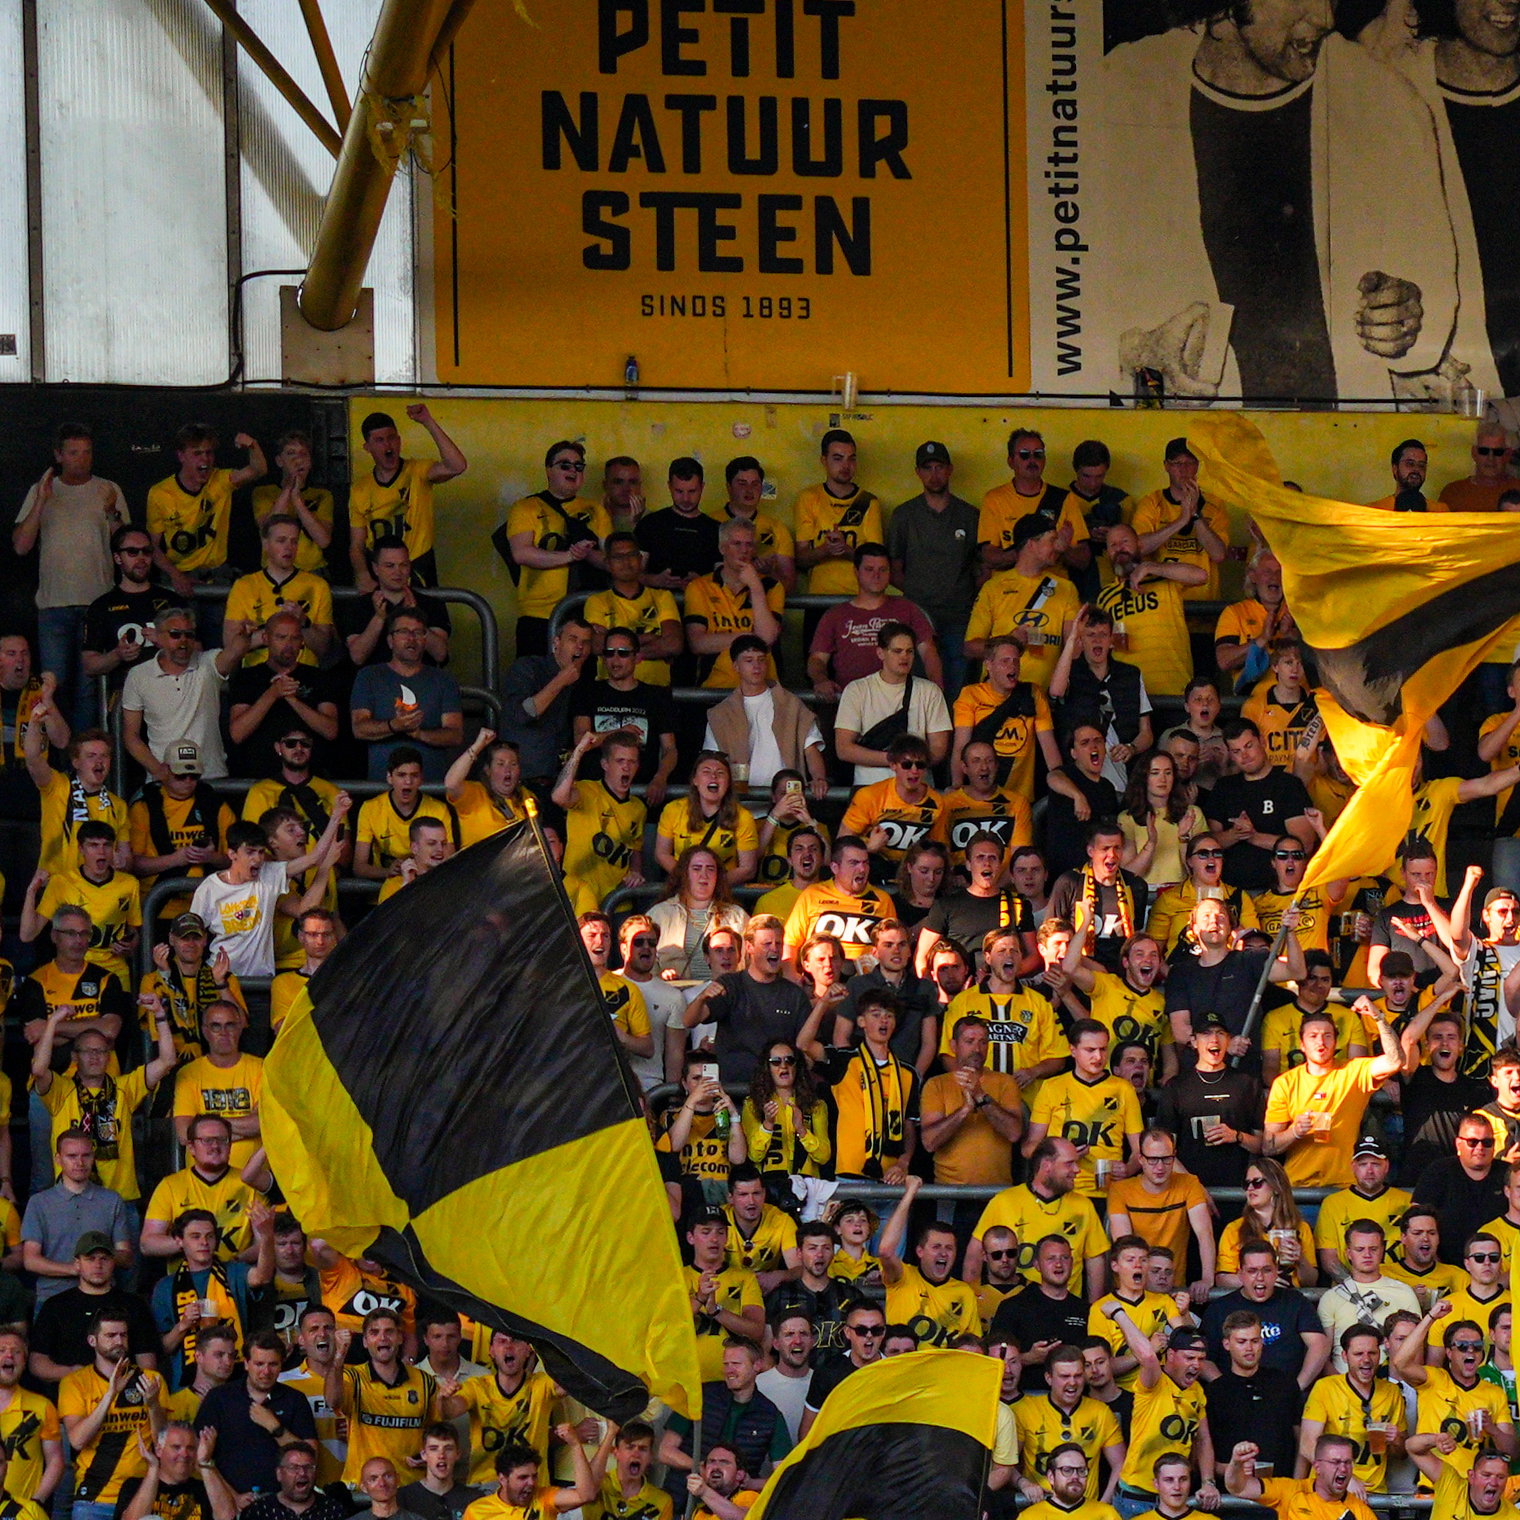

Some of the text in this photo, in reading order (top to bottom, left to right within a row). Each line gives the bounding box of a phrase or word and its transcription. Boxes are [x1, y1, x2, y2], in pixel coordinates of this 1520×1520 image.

[600, 0, 855, 79] PETIT
[542, 91, 912, 180] NATUUR
[1044, 0, 1088, 376] www.petitnatuur
[582, 191, 871, 276] STEEN
[641, 295, 811, 319] SINDS 1893
[1264, 799, 1273, 814] B
[879, 822, 928, 849] OK
[951, 816, 1007, 846] OK
[592, 834, 631, 868] OK
[815, 912, 878, 943] OK
[1063, 1120, 1115, 1146] OK
[353, 1291, 400, 1316] OK
